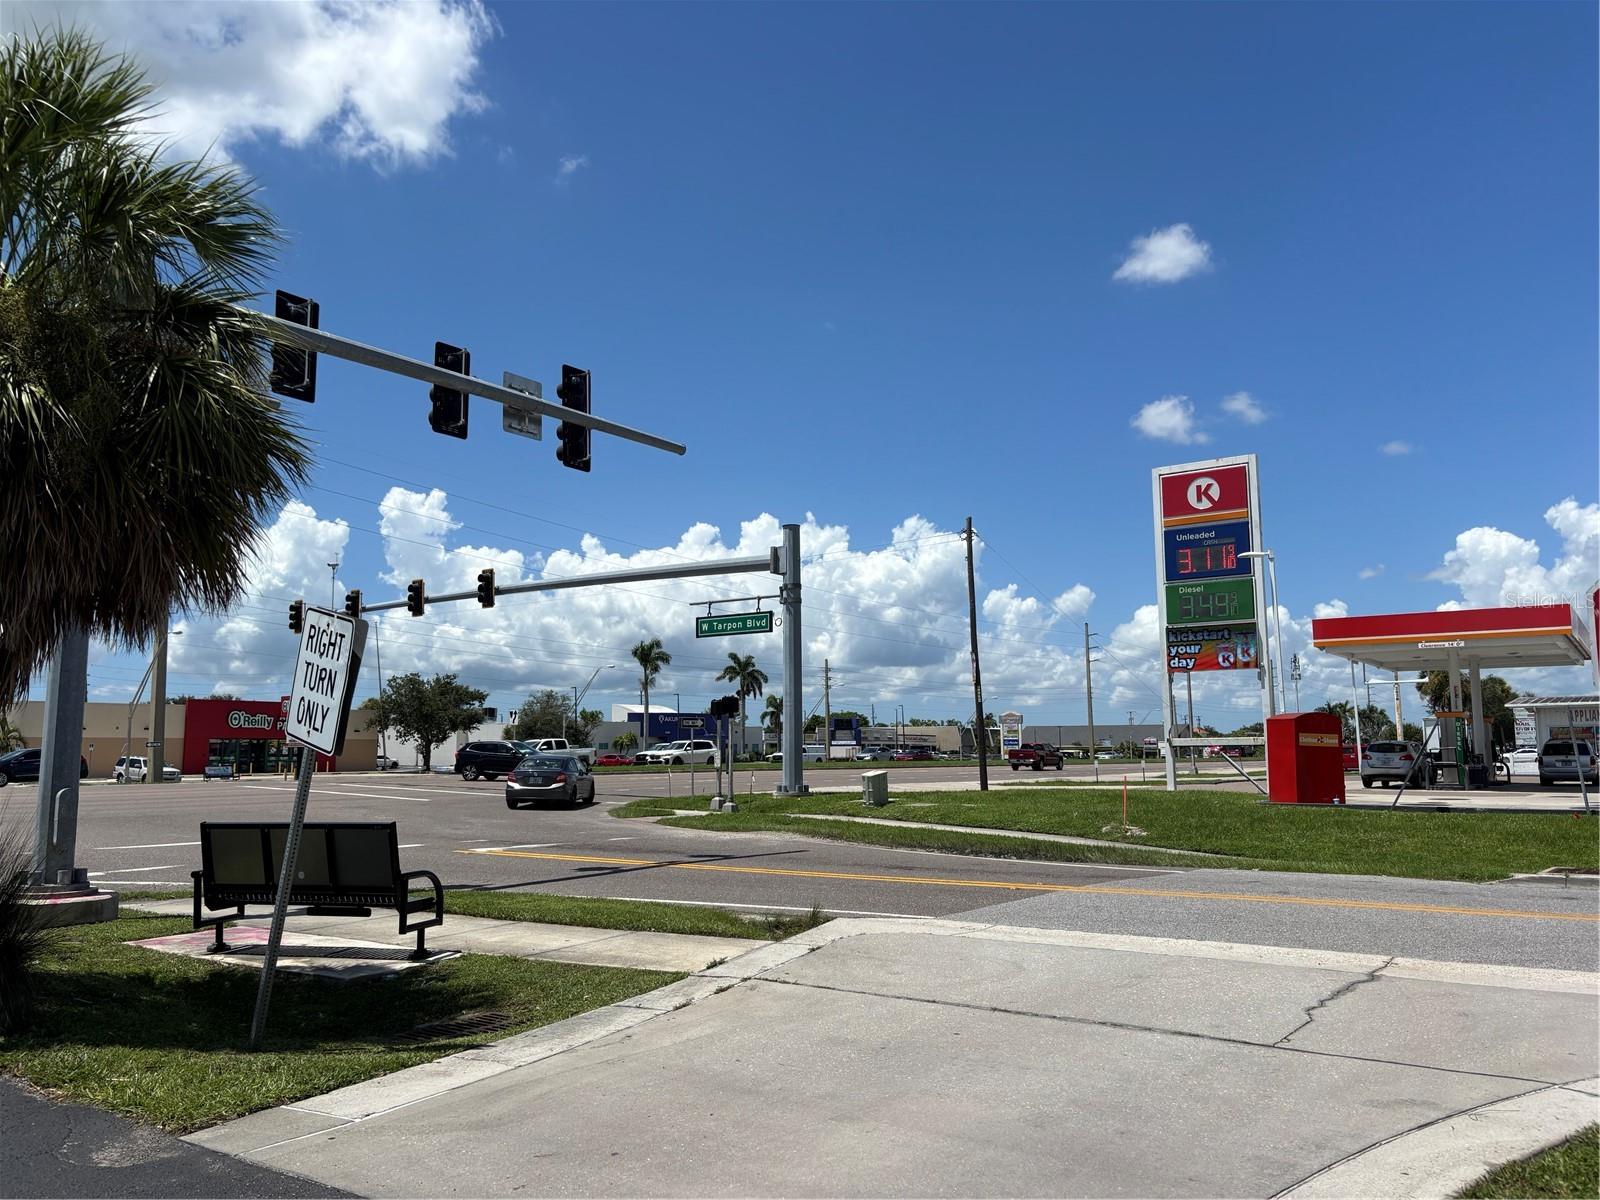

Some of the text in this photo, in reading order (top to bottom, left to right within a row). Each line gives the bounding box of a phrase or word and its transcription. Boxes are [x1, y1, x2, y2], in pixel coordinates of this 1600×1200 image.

[1176, 530, 1216, 541] Unleaded
[1178, 585, 1204, 594] Diesel
[701, 618, 767, 631] W Tarpon Blvd
[1168, 628, 1231, 642] kickstart
[305, 623, 346, 662] RIGHT
[1168, 643, 1201, 657] your
[1169, 657, 1196, 669] day
[303, 660, 338, 698] TURN
[229, 711, 274, 730] O'Reilly
[296, 696, 330, 734] ONLY
